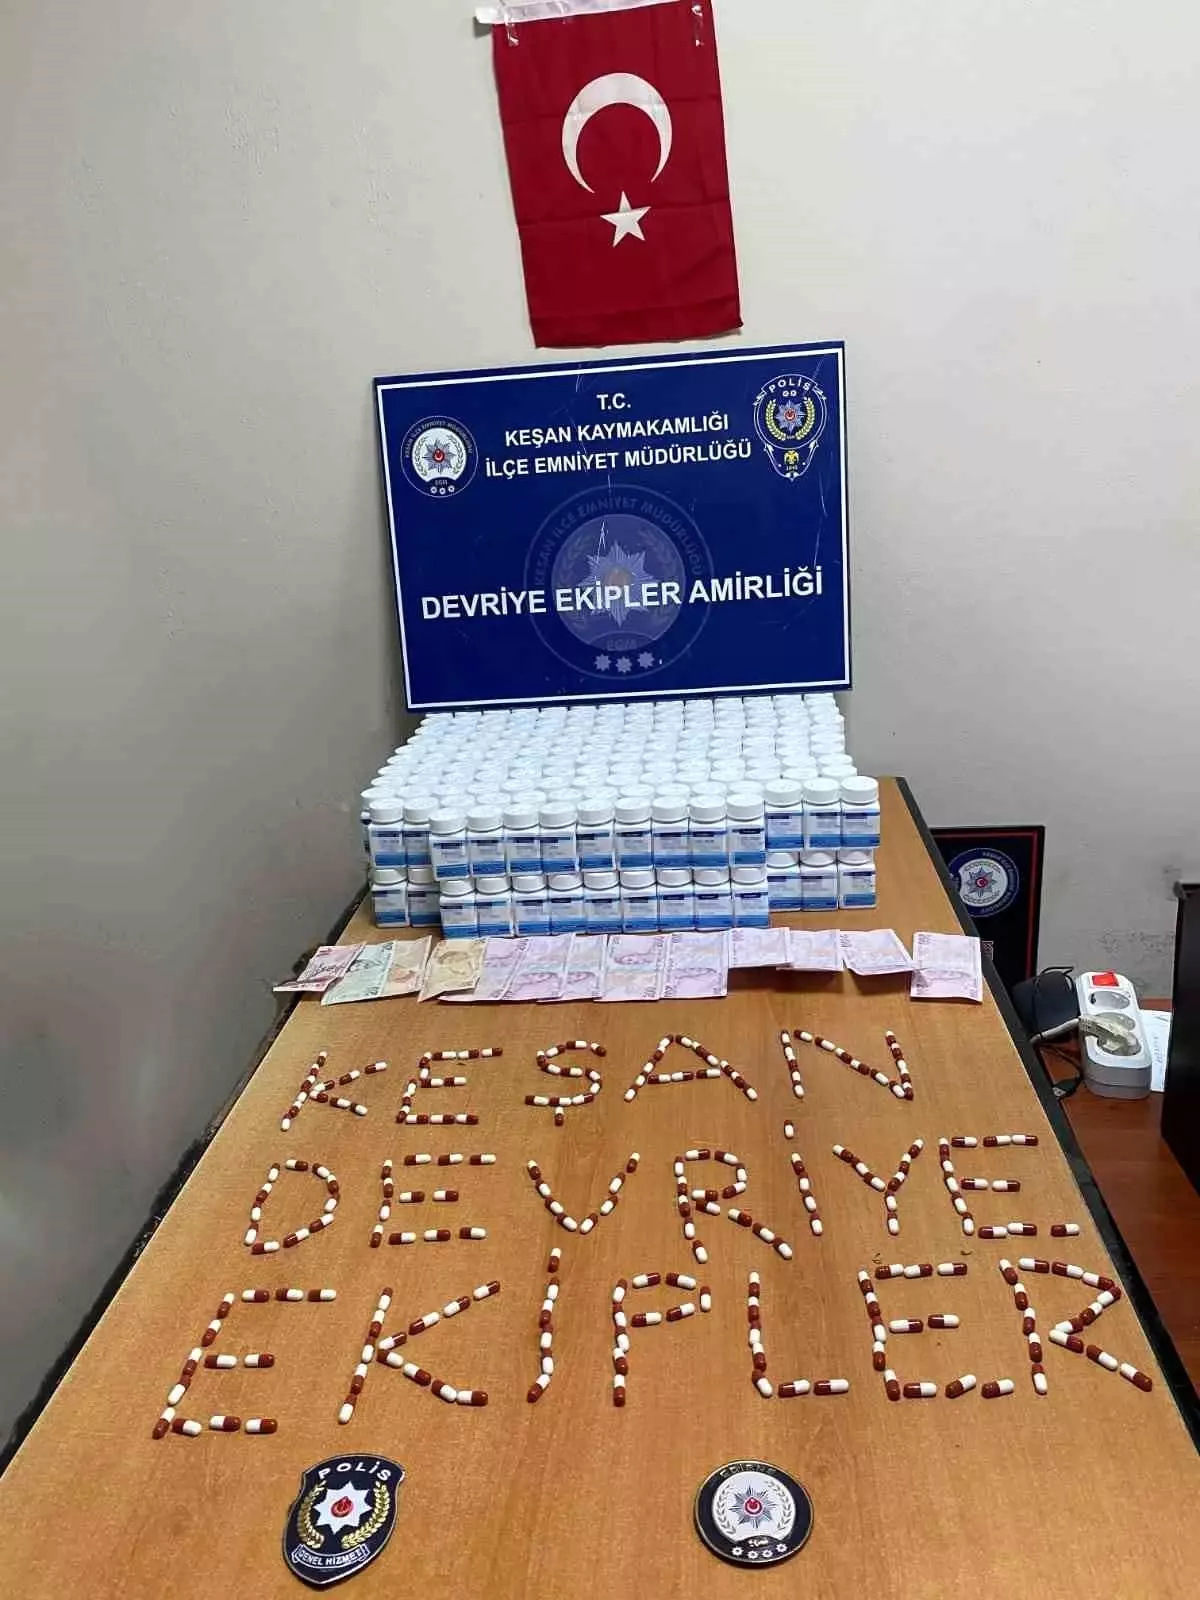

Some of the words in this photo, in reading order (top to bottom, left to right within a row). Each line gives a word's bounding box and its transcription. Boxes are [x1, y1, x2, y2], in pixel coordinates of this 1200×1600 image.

[596, 392, 632, 410] T.C.
[505, 426, 572, 449] KEŞAN
[577, 410, 729, 441] KAYMAKAMLIĞI
[485, 457, 529, 480] İLÇE
[534, 450, 619, 474] EMNİYET
[625, 438, 752, 468] MÜDÜRLÜĞÜ
[421, 586, 547, 620] DEVRİYE
[555, 579, 682, 613] EKİPLER
[688, 565, 823, 605] AMİRLİĞİ
[280, 1029, 914, 1131] KEŞAN
[244, 1119, 1080, 1263] DEVRİYE
[152, 1247, 1153, 1439] EKİPLER
[318, 1461, 391, 1481] POLİS
